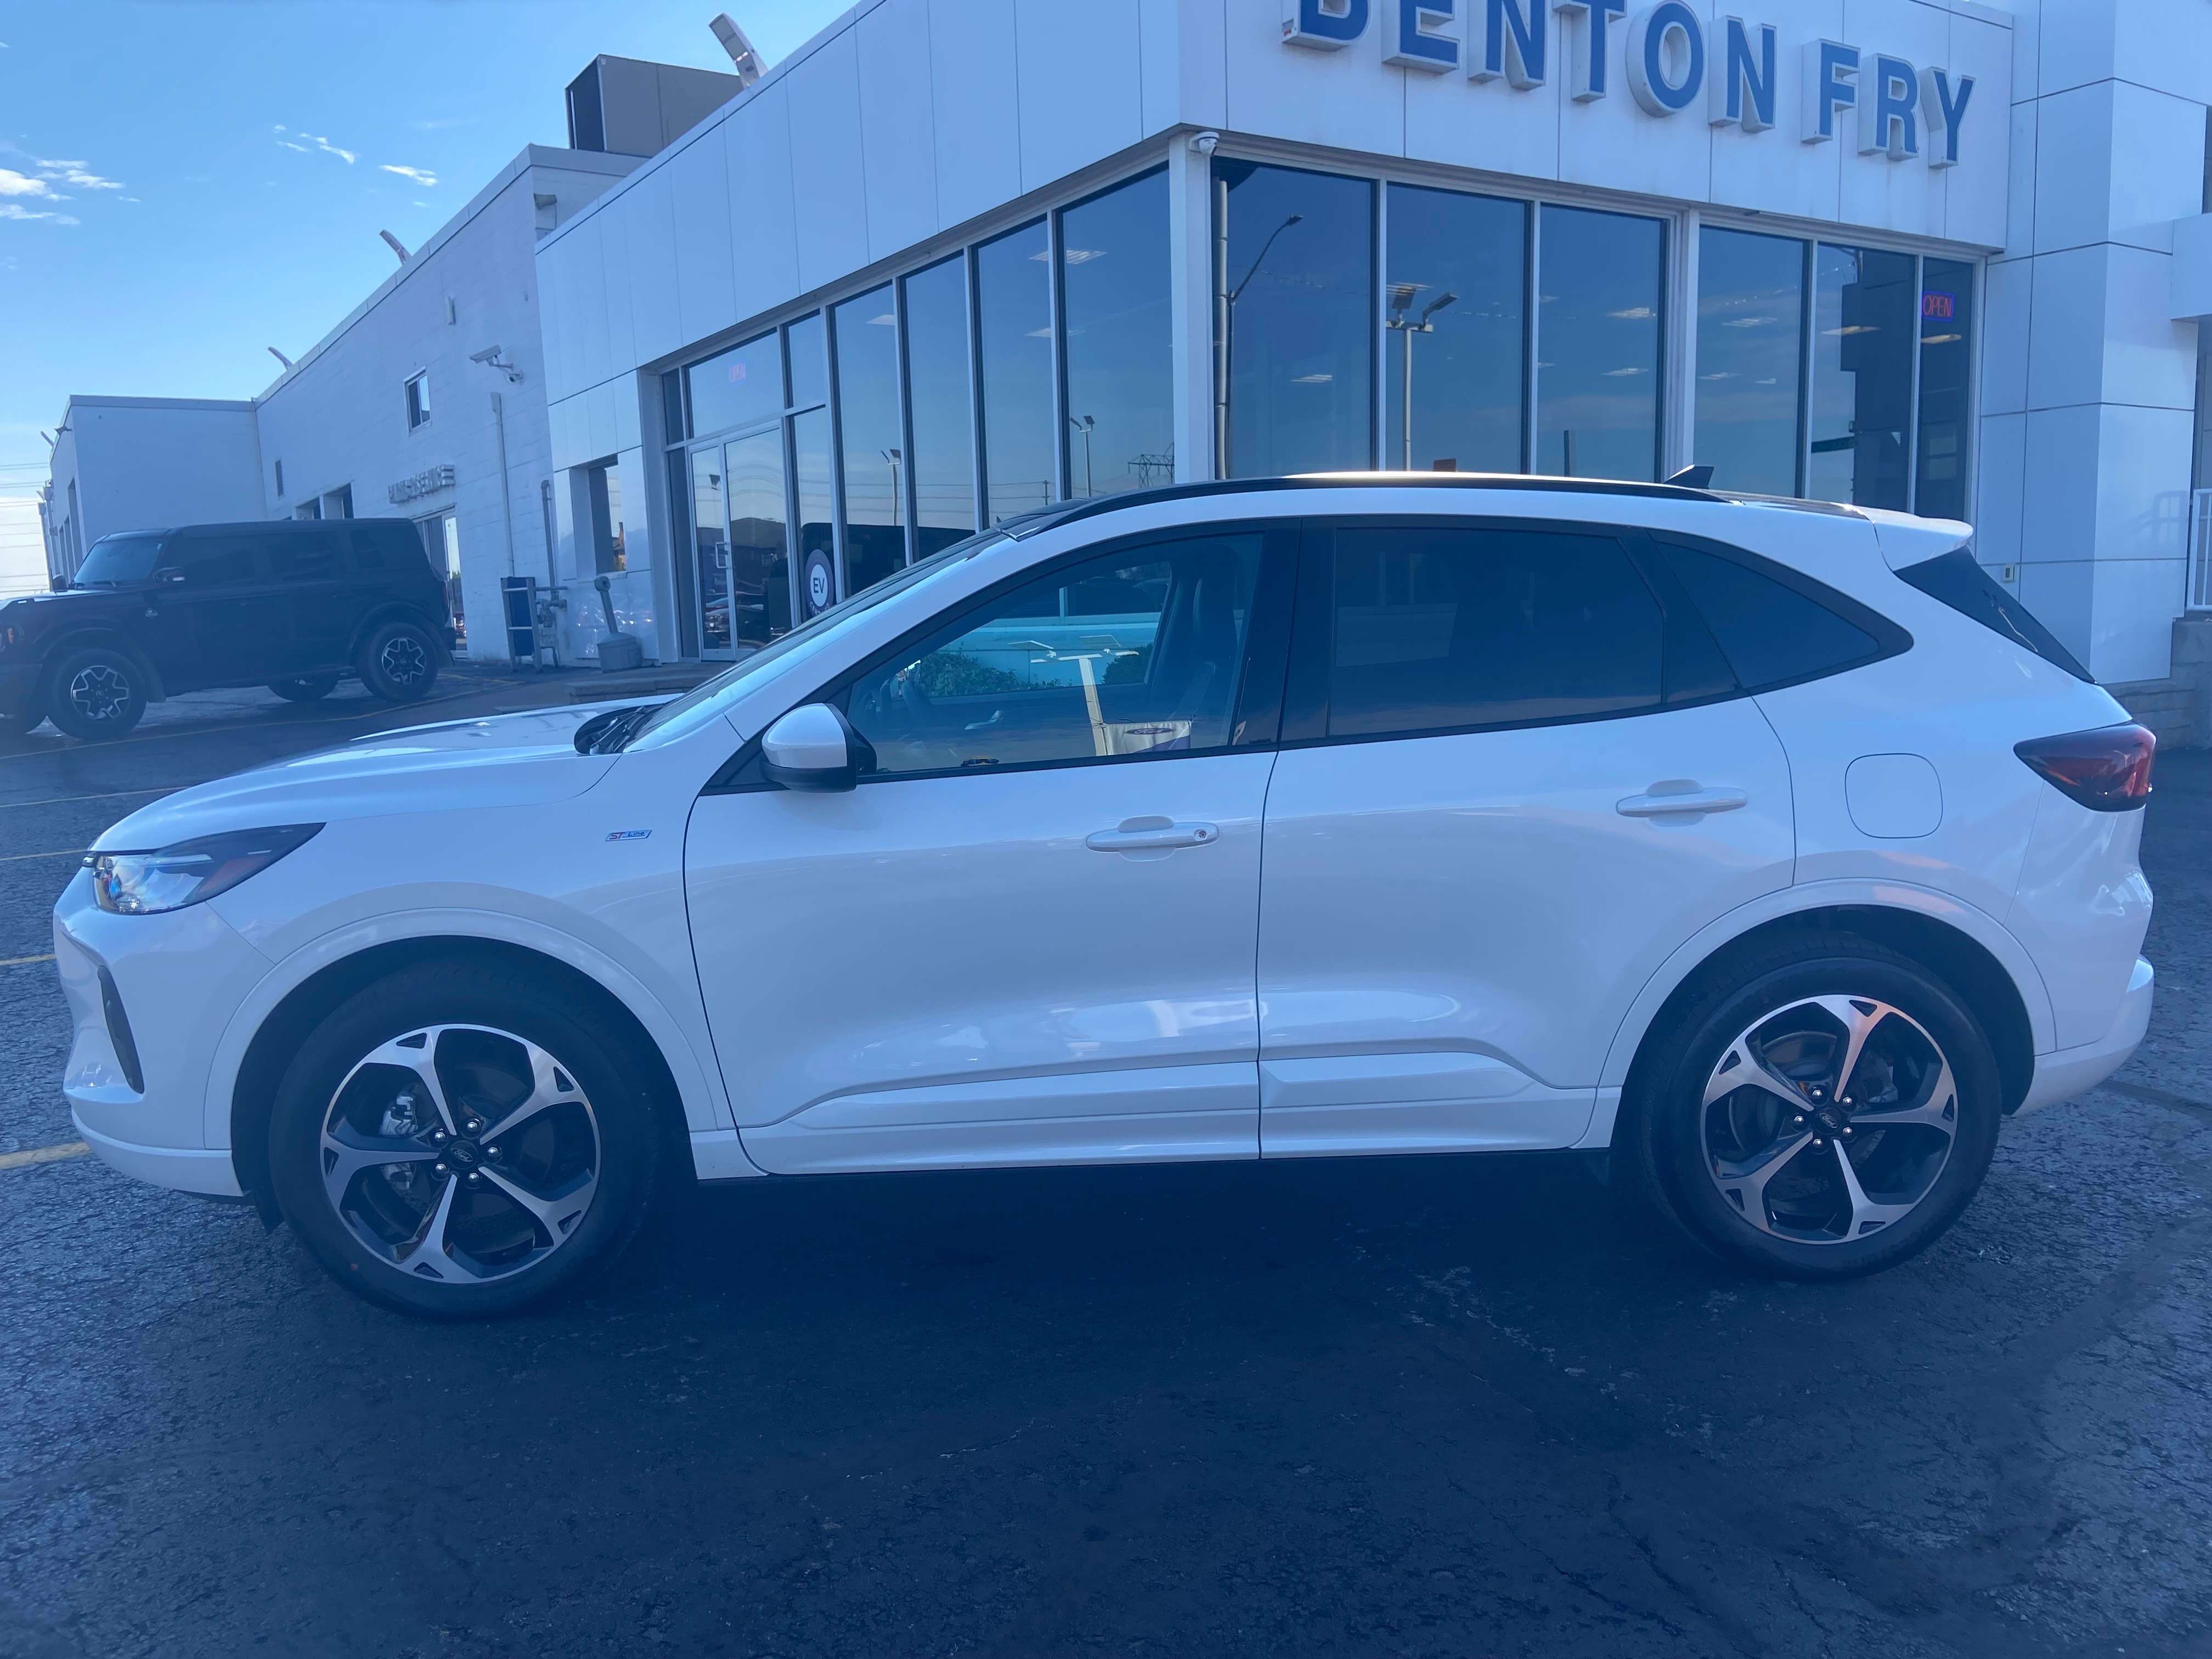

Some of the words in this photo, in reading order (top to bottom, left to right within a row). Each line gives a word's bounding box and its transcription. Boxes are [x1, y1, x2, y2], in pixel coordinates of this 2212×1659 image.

[1801, 38, 1976, 168] FRY
[1923, 295, 1952, 318] OPEN
[813, 577, 825, 594] EV
